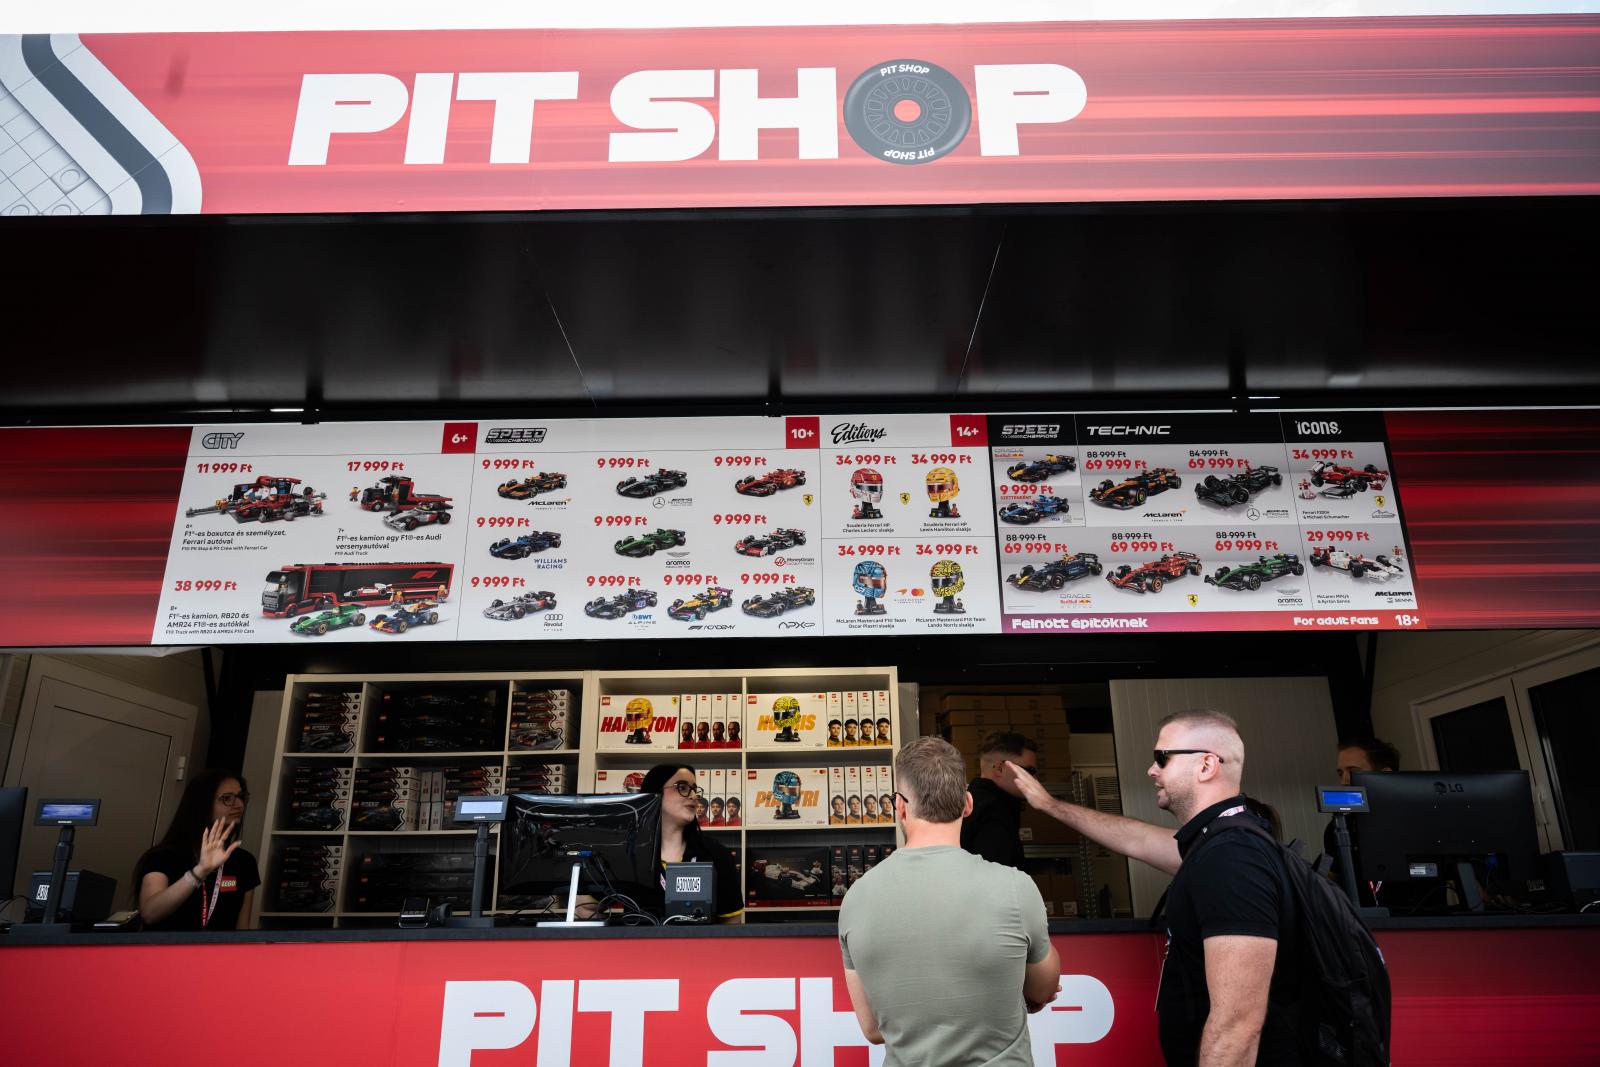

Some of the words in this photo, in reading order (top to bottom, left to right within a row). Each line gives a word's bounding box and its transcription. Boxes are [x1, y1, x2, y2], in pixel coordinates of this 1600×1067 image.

[880, 64, 898, 76] PIT
[898, 64, 930, 74] SHOP
[288, 71, 580, 166] PIT
[608, 58, 1088, 165] SHOP
[884, 149, 916, 160] SHOP
[917, 147, 935, 160] PIT
[486, 428, 547, 439] SPEED
[791, 428, 814, 439] 10+
[831, 422, 887, 445] Editions
[956, 426, 979, 437] 14+
[1001, 424, 1061, 435] SPEED
[1086, 425, 1172, 436] TECHNIC
[201, 432, 245, 449] CITY
[451, 433, 468, 444] 6+
[837, 455, 853, 465] 34
[856, 454, 881, 464] 999
[884, 456, 897, 465] Ft
[912, 454, 929, 464] 34
[930, 453, 956, 464] 999
[960, 454, 972, 464] Ft
[1293, 450, 1310, 459] 34
[1312, 449, 1337, 458] 999
[1341, 451, 1354, 459] Ft
[482, 460, 492, 468] 9
[494, 459, 521, 469] 999
[522, 460, 535, 469] Ft
[598, 458, 606, 468] 9
[609, 458, 634, 468] 999
[637, 458, 649, 468] Ft
[715, 456, 724, 465] 9
[726, 455, 751, 465] 999
[754, 457, 767, 465] Ft
[1085, 459, 1104, 470] 69
[1105, 459, 1132, 470] 999
[1135, 460, 1148, 470] Ft
[1188, 458, 1206, 469] 69
[1208, 458, 1234, 468] 999
[1237, 459, 1249, 469] Ft
[197, 463, 209, 472] 11
[211, 463, 238, 473] 999
[240, 463, 252, 472] Ft
[347, 460, 362, 472] 17
[363, 460, 391, 472] 999
[391, 461, 405, 471] Ft
[1000, 484, 1009, 494] 9
[1011, 483, 1037, 494] 999
[1040, 484, 1053, 495] Ft
[476, 517, 486, 527] 9
[488, 517, 514, 527] 999
[518, 518, 529, 527] Ft
[594, 514, 603, 526] 9
[606, 515, 632, 526] 999
[635, 516, 647, 526] Ft
[713, 514, 723, 524] 9
[725, 513, 752, 524] 999
[754, 515, 767, 524] Ft
[1216, 531, 1228, 539] 88
[1229, 531, 1245, 539] 999
[1247, 531, 1256, 539] Ft
[1307, 530, 1325, 542] 29
[1326, 530, 1353, 541] 999
[1356, 532, 1369, 541] Ft
[838, 545, 856, 556] 34
[858, 545, 885, 556] 999
[888, 546, 902, 555] Ft
[917, 544, 934, 555] 34
[936, 544, 962, 554] 999
[965, 545, 978, 555] Ft
[1004, 543, 1023, 554] 69
[1024, 543, 1051, 553] 999
[1054, 544, 1068, 553] Ft
[1111, 541, 1130, 553] 69
[1130, 541, 1158, 552] 999
[1161, 542, 1174, 553] Ft
[1216, 540, 1234, 552] 69
[1235, 540, 1262, 551] 999
[1264, 541, 1279, 551] Ft
[471, 576, 481, 587] 9
[483, 576, 509, 587] 999
[512, 577, 525, 588] Ft
[587, 576, 597, 586] 9
[599, 576, 625, 586] 999
[628, 576, 641, 587] Ft
[663, 576, 673, 585] 9
[676, 574, 702, 585] 999
[706, 576, 717, 585] Ft
[741, 573, 751, 584] 9
[752, 573, 780, 584] 999
[781, 574, 796, 584] Ft
[175, 579, 192, 592] 38
[194, 579, 222, 591] 999
[223, 580, 237, 590] Ft
[1293, 616, 1315, 626] For
[1316, 616, 1349, 626] adult
[1395, 614, 1420, 626] 18+
[600, 716, 678, 733] HATON
[438, 978, 680, 1067] PIT
[706, 974, 1115, 1067] SHP
